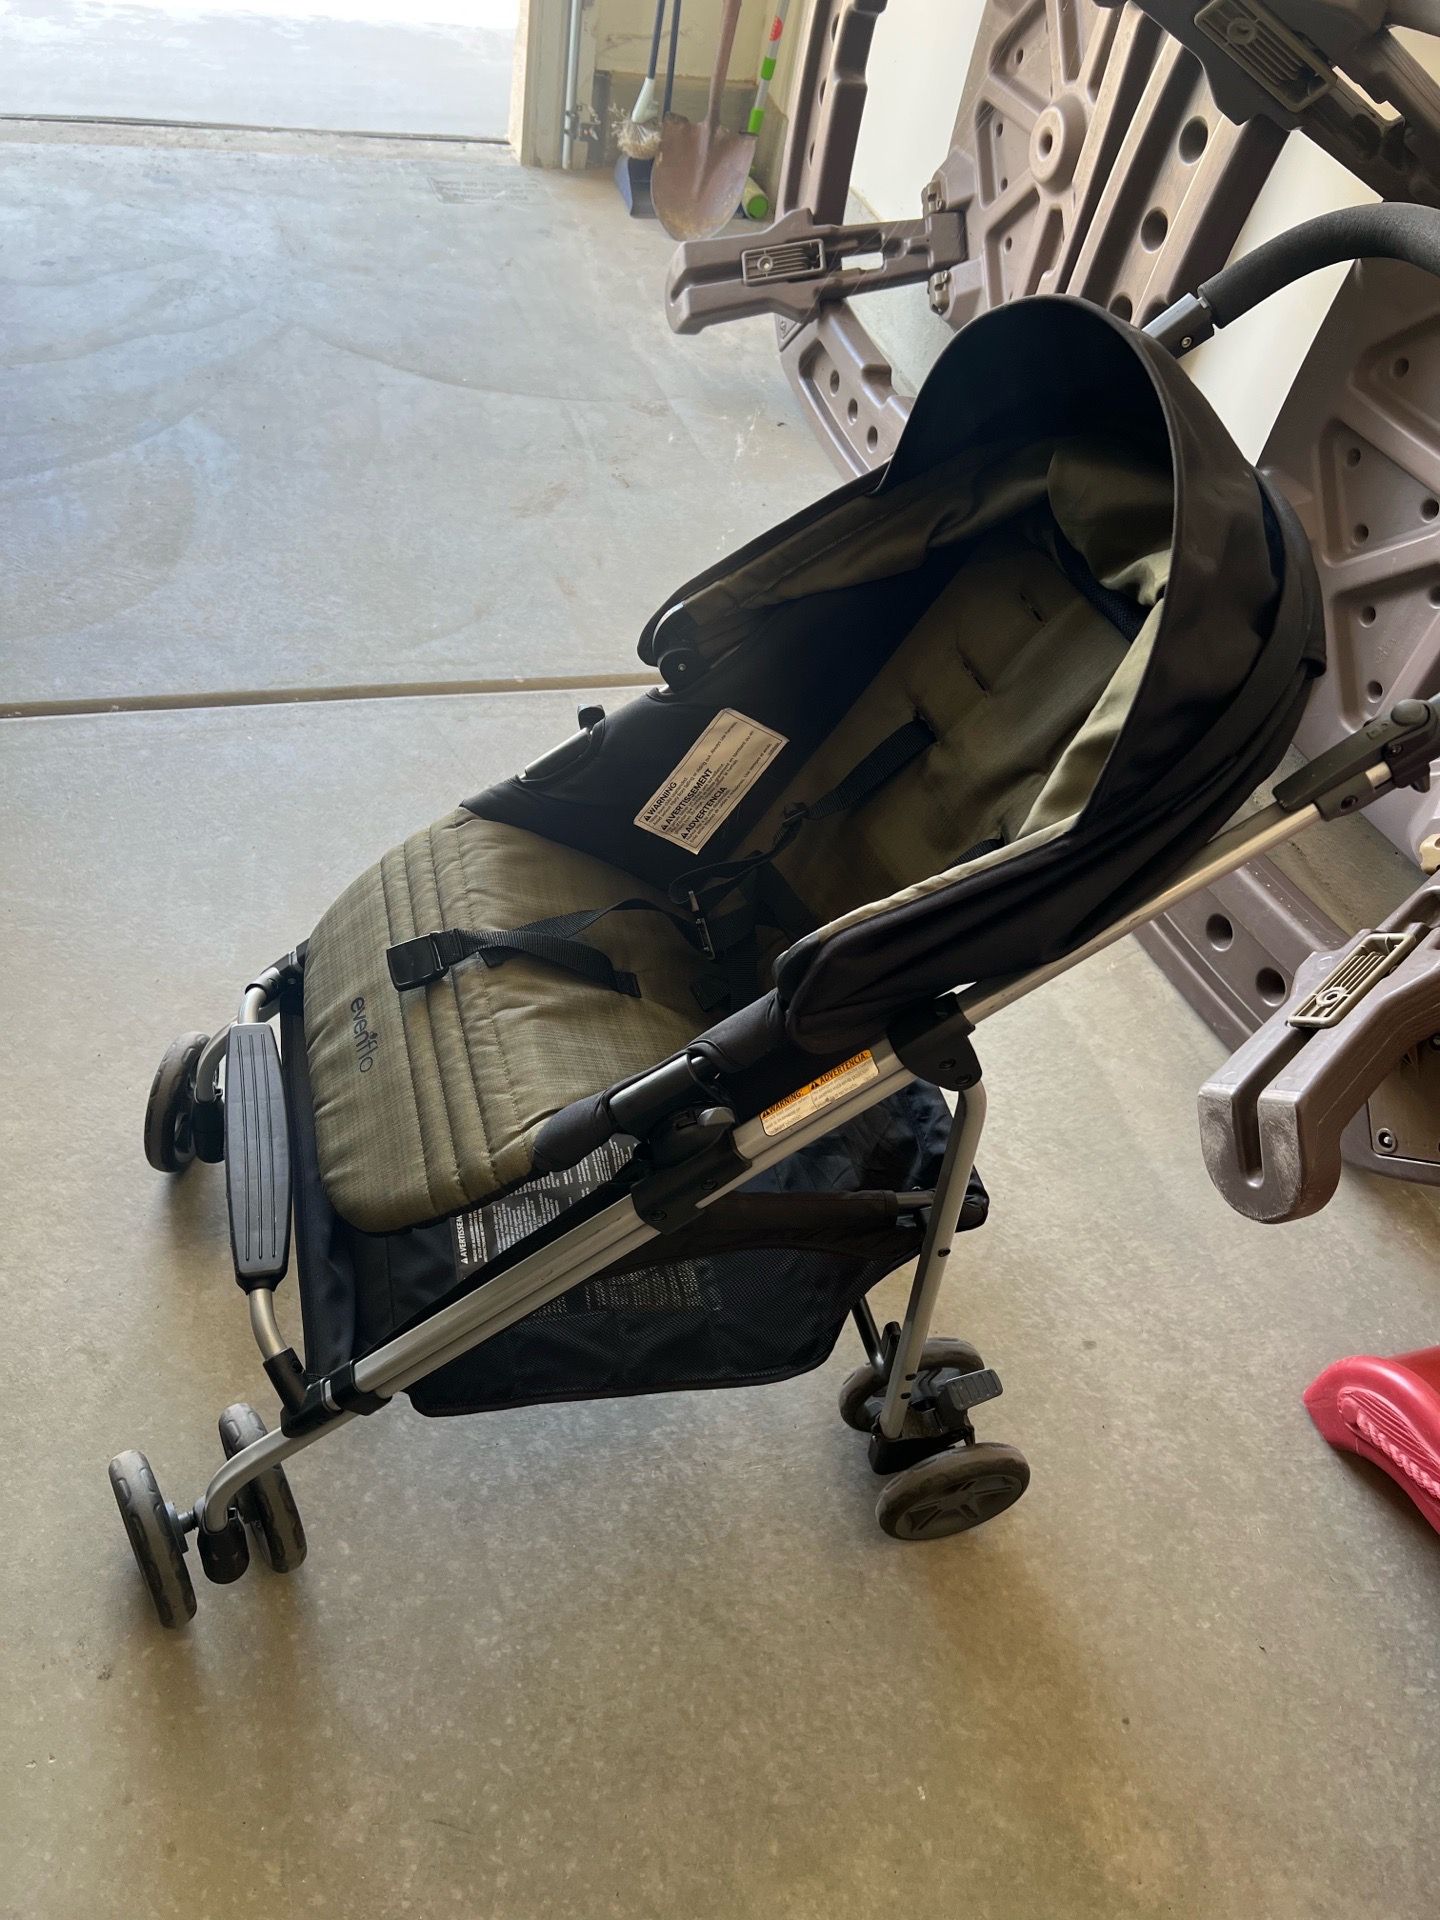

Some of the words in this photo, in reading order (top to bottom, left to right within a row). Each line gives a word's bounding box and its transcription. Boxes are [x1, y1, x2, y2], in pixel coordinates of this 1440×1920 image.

[648, 782, 677, 816] WARNING
[666, 768, 713, 825] AVERTISSEMENT
[685, 787, 728, 833] ADVERTENCIA
[351, 996, 378, 1073] evenflo
[819, 1052, 868, 1084] ADVERTENCIA:
[769, 1089, 803, 1113] WARNING:
[456, 1215, 468, 1257] AVERTISSEM
